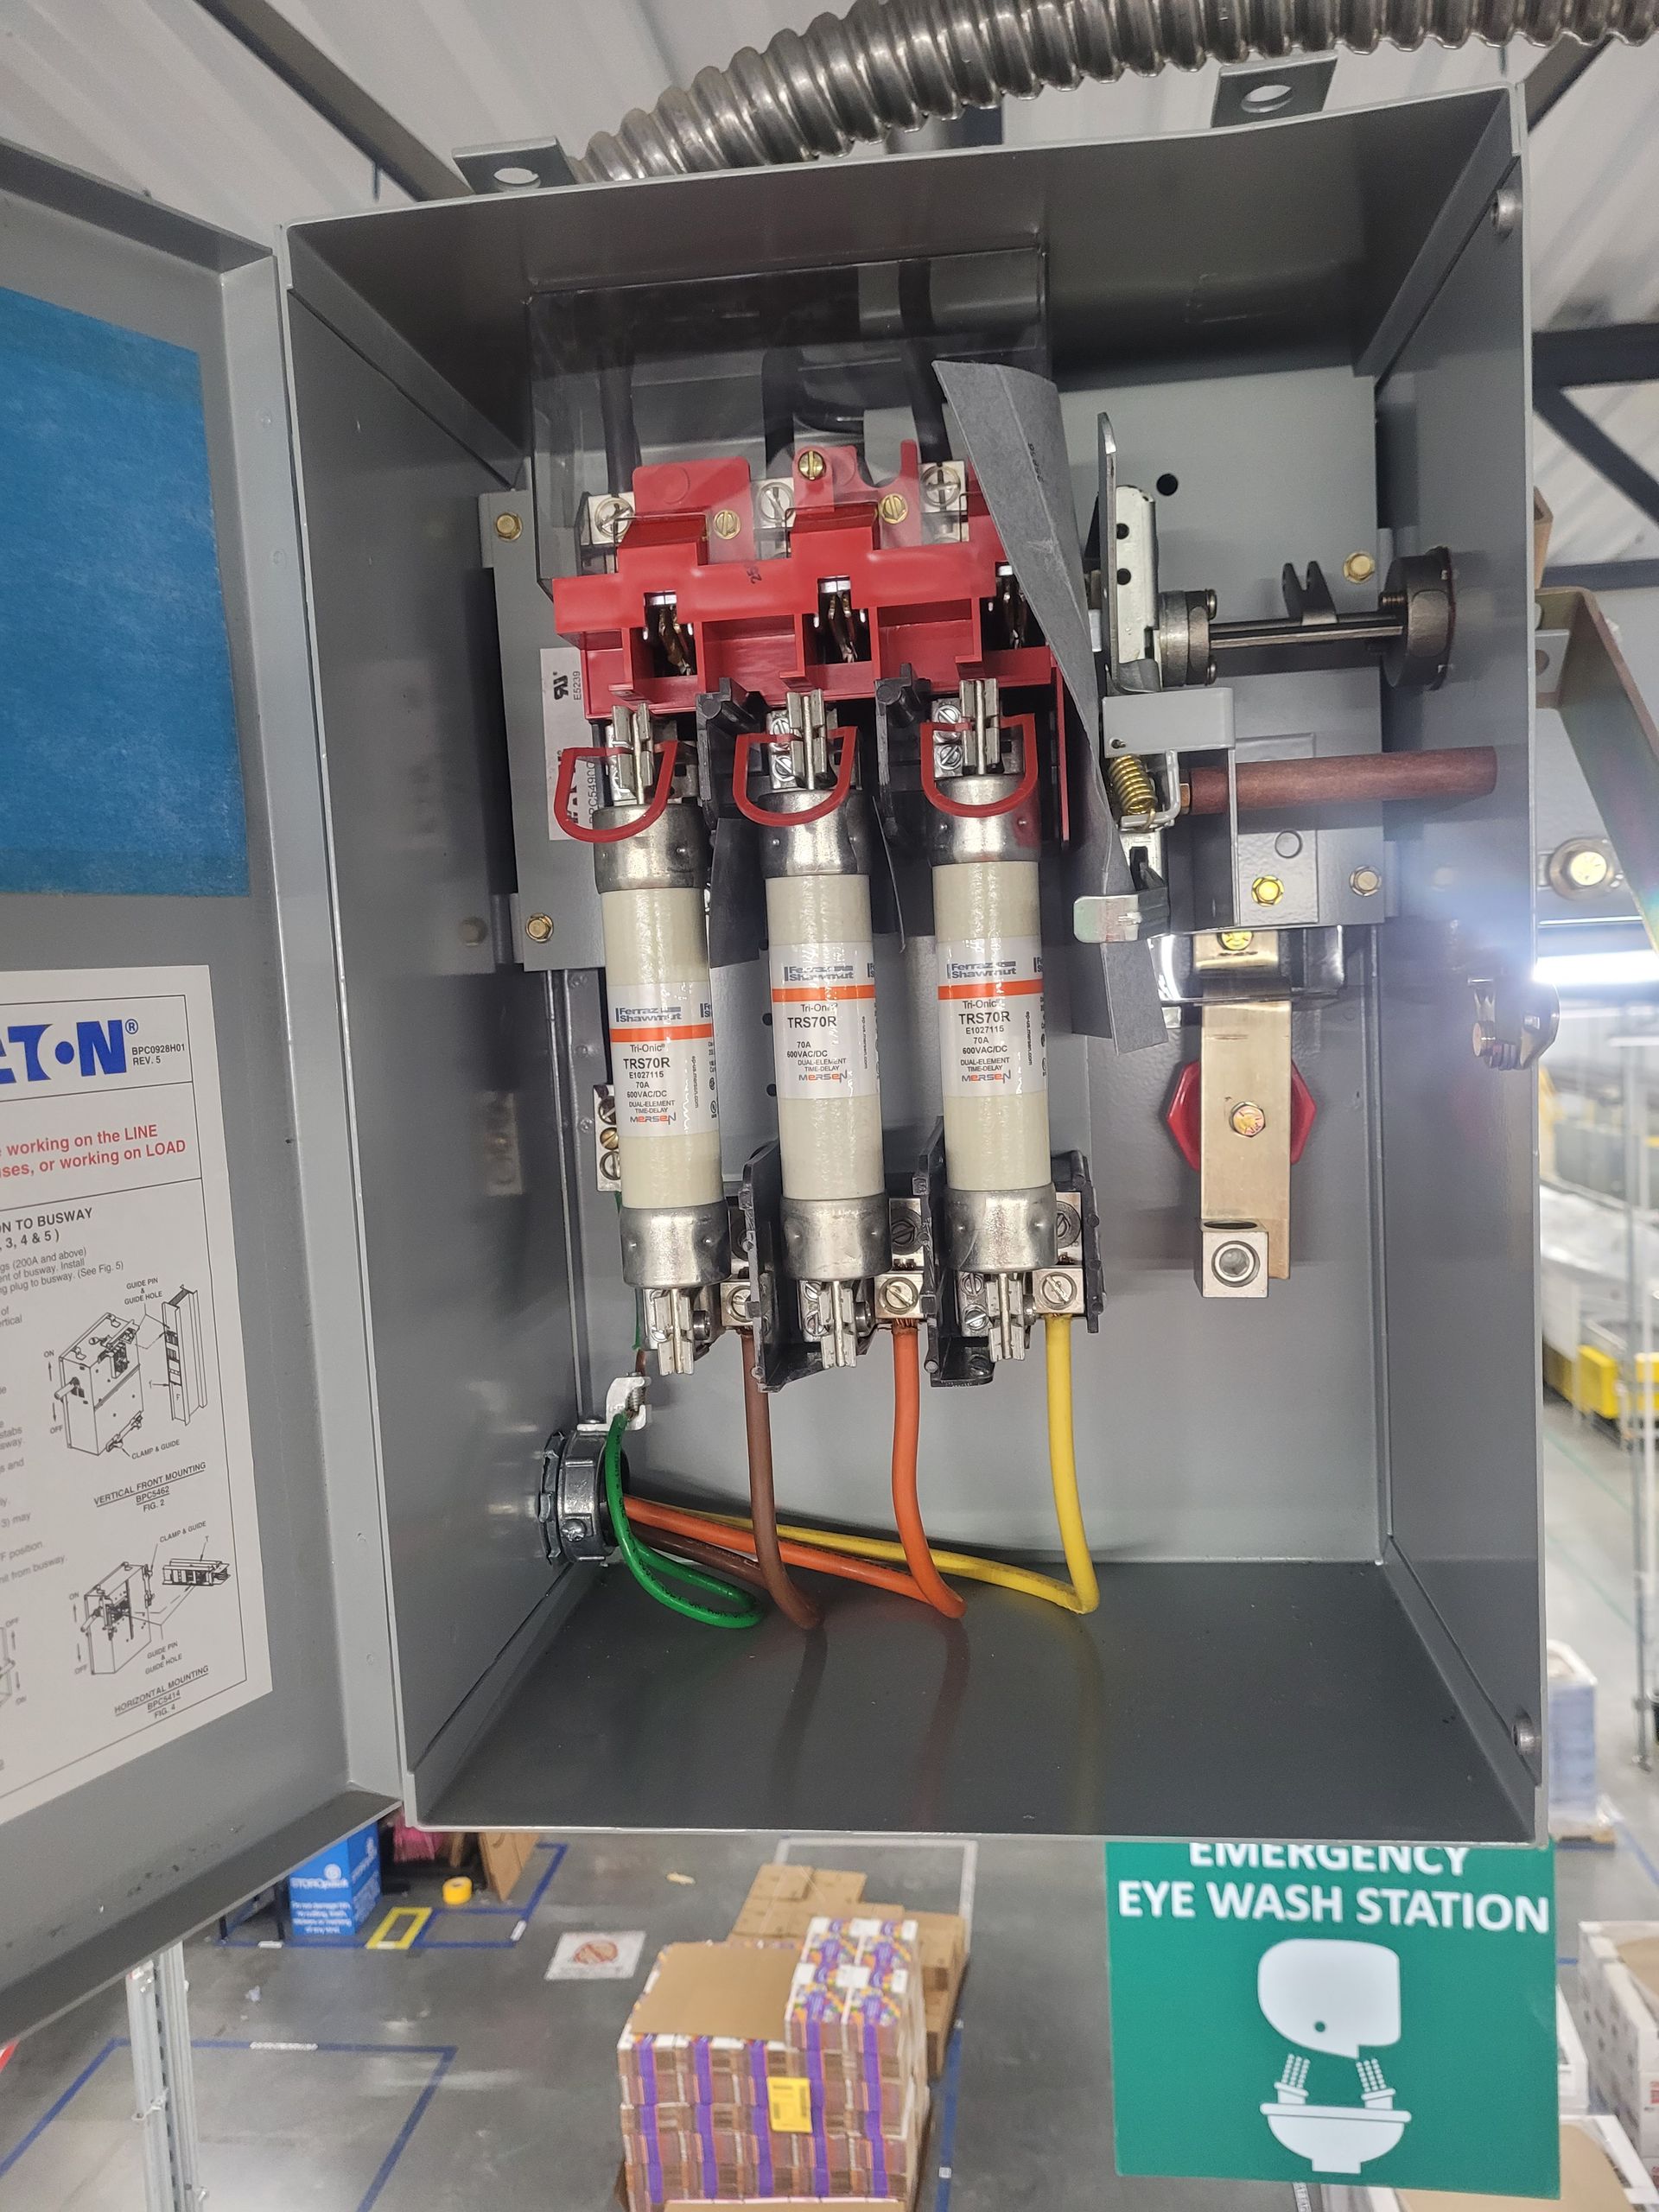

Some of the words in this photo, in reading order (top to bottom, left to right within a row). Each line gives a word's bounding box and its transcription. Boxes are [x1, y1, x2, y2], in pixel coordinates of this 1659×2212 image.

[573, 671, 582, 701] E5239
[787, 1016, 837, 1028] TRS70R
[958, 1011, 1011, 1025] TRS70R
[966, 1026, 1004, 1034] E1027115
[132, 1044, 185, 1055] BPC0928H01
[963, 1046, 1007, 1054] 600VAC/DC
[132, 1057, 154, 1065] REV.
[623, 1057, 671, 1070] TRS70R
[961, 1057, 1010, 1065] DUAL-ELEMENT
[7, 1137, 70, 1156] working
[74, 1135, 92, 1147] on
[98, 1130, 120, 1144] the
[124, 1124, 157, 1141] LINE
[0, 1163, 35, 1178] ses,
[40, 1160, 54, 1172] or
[60, 1151, 119, 1169] working
[124, 1147, 142, 1160] on
[146, 1140, 186, 1156] LOAD
[16, 1218, 33, 1230] TO
[37, 1207, 92, 1227] BUSWAY
[21, 1234, 28, 1245] 4
[32, 1232, 41, 1243] &
[13, 1256, 38, 1271] (200A
[41, 1252, 56, 1263] and
[59, 1247, 86, 1261] above)
[10, 1280, 29, 1294] plug
[30, 1278, 39, 1288] to
[41, 1271, 75, 1285] busway.
[78, 1268, 96, 1279] (See
[116, 1261, 124, 1271] 5)
[13, 1270, 22, 1280] of
[61, 1258, 85, 1270] Install
[126, 1280, 146, 1289] GUIDE
[148, 1277, 158, 1286] PIN
[124, 1295, 143, 1305] GUIDE
[147, 1291, 163, 1300] HOLE
[50, 1425, 63, 1434] OFF
[131, 1447, 154, 1459] CLAMP
[161, 1439, 181, 1451] GUIDE
[93, 1486, 134, 1505] VERTICAL
[137, 1476, 163, 1491] FRONT
[165, 1462, 207, 1481] MOUNTING
[136, 1486, 170, 1503] BPC5462
[143, 1502, 158, 1512] FIG.
[12, 1512, 30, 1523] may
[160, 1529, 181, 1542] CLAMP
[188, 1521, 207, 1532] GUIDE
[69, 1592, 79, 1600] ON
[147, 1647, 166, 1659] GUIDE
[168, 1641, 178, 1650] PIN
[145, 1662, 164, 1675] GUIDE
[166, 1653, 182, 1665] HOLE
[114, 1686, 166, 1713] HORIZONTAL
[168, 1665, 209, 1689] MOUNTING
[147, 1689, 181, 1710] BPC5414
[1189, 1842, 1471, 1876] EMERGENCY
[1117, 1880, 1197, 1918] EYE
[1206, 1881, 1344, 1923] WASH
[1356, 1886, 1551, 1934] STATION
